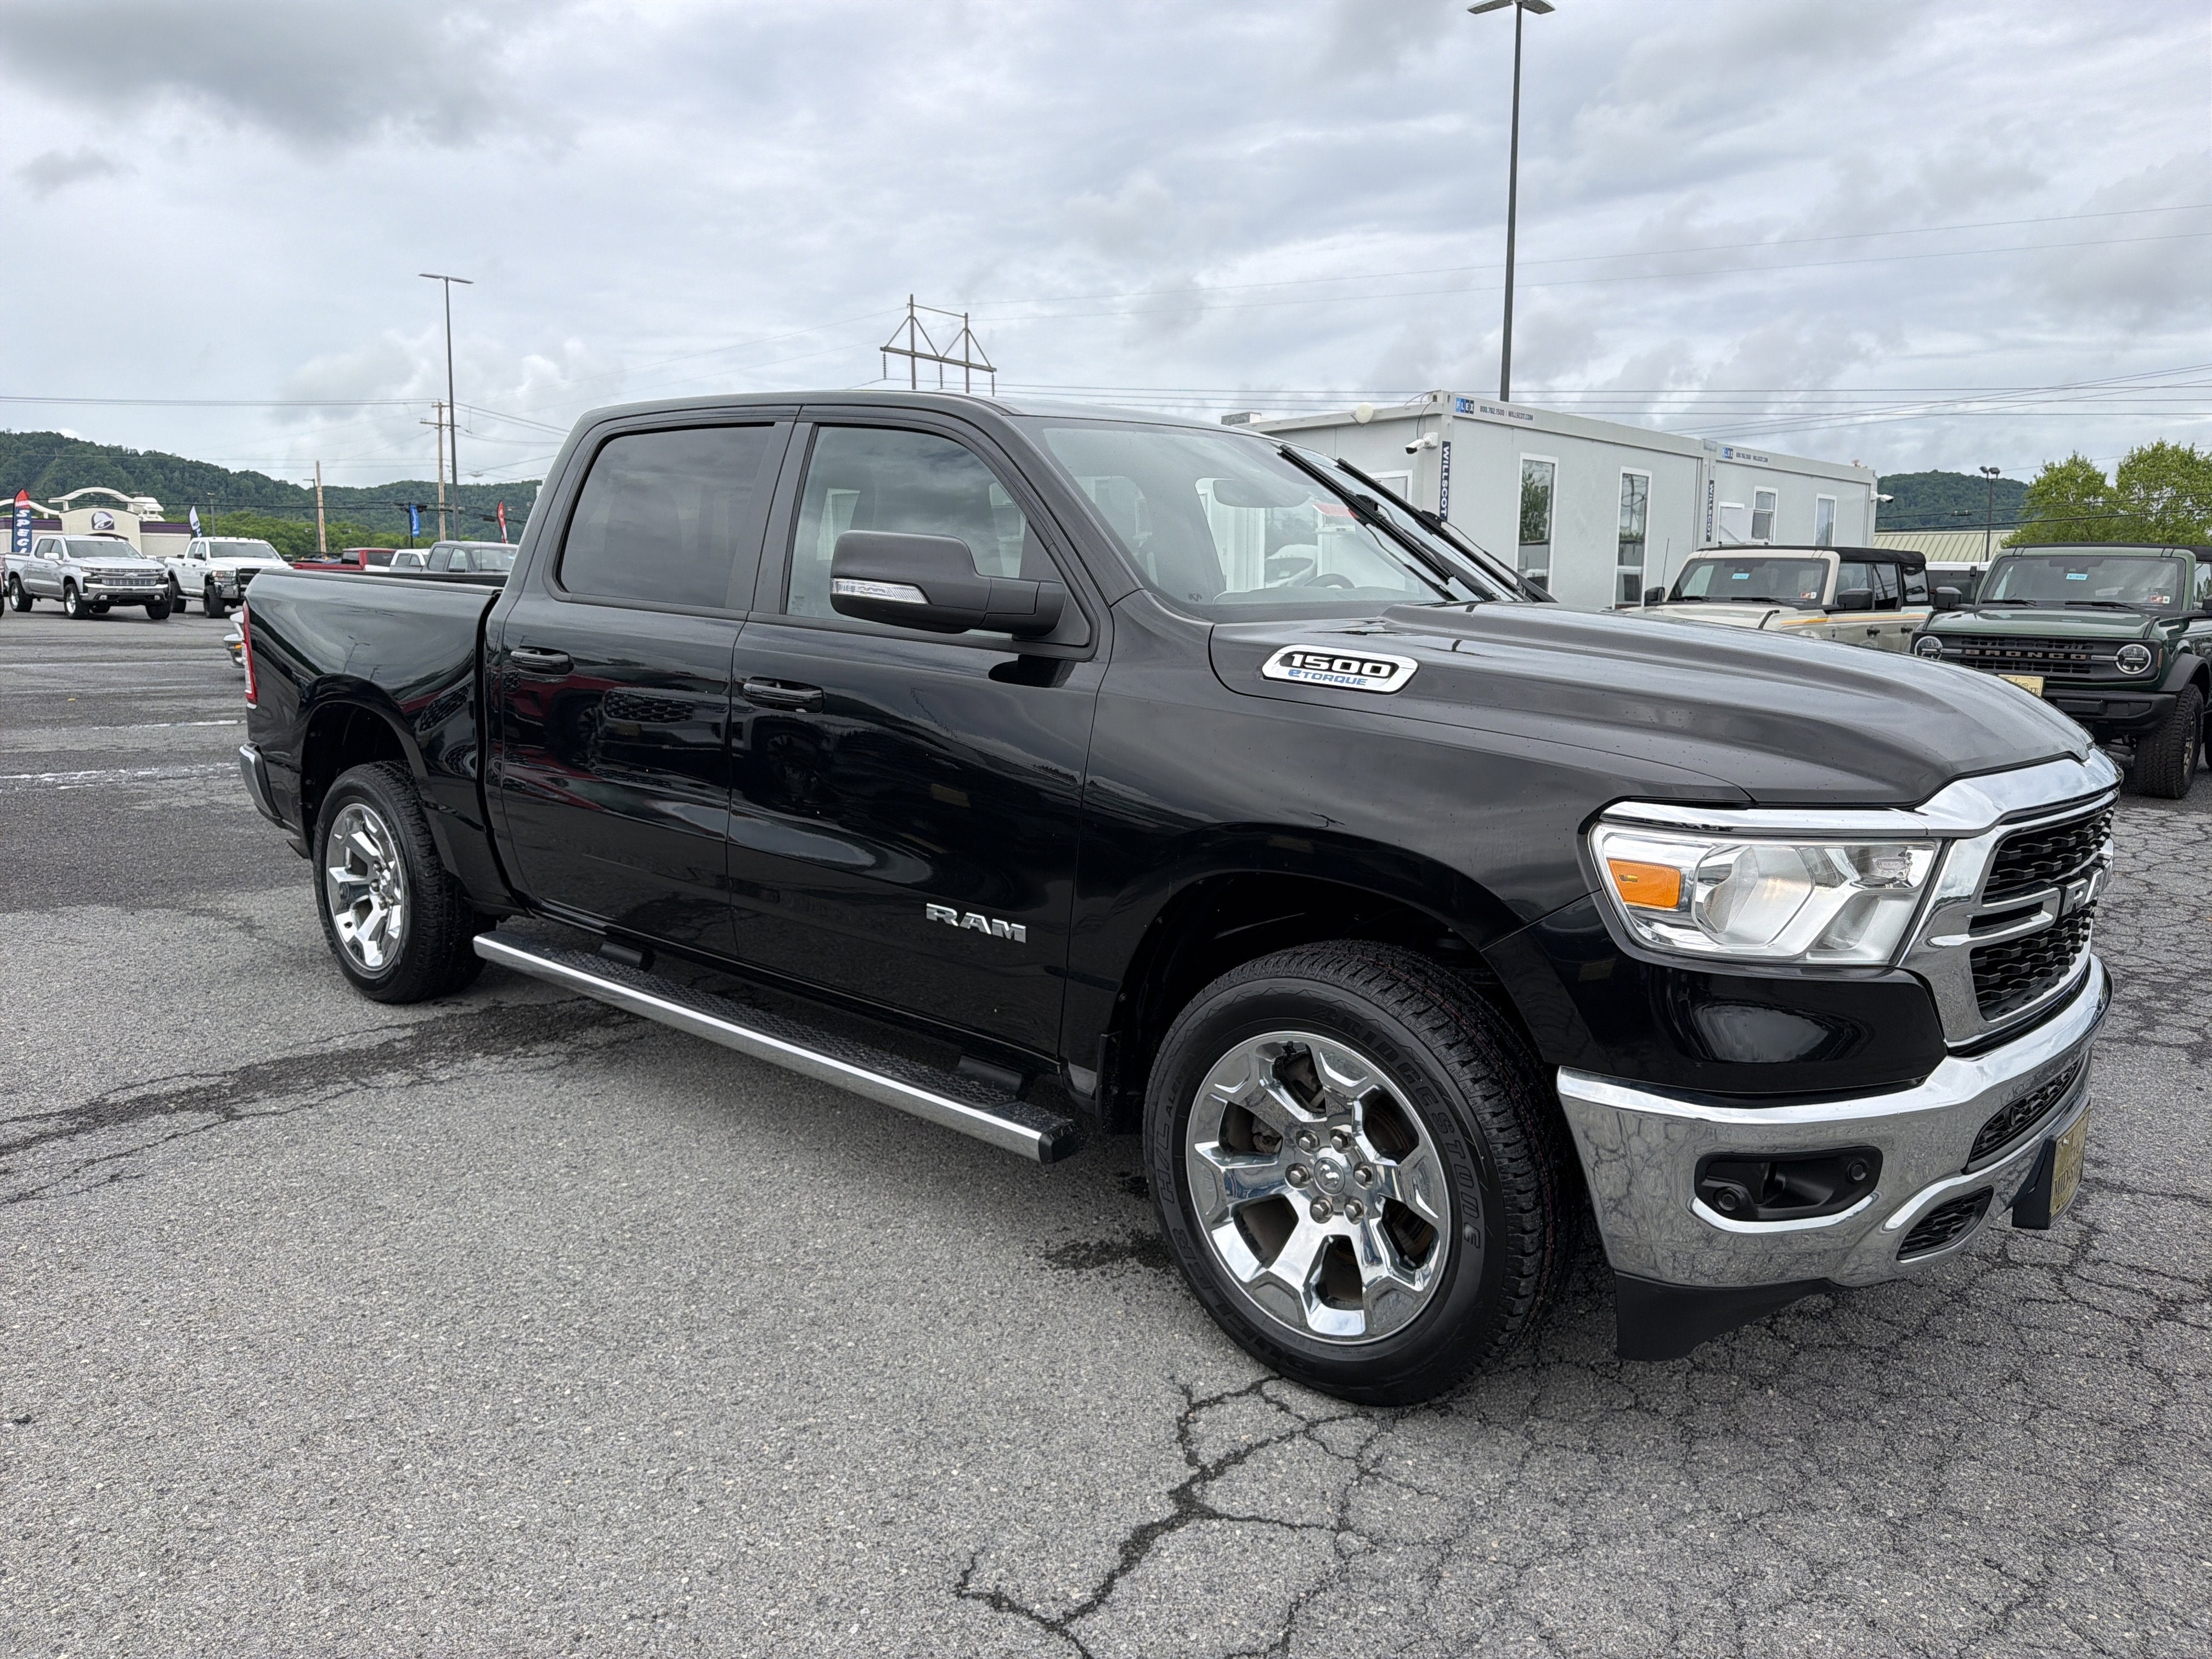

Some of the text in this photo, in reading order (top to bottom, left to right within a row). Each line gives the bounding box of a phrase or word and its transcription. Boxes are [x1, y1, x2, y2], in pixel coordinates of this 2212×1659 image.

[1456, 400, 1474, 413] FLEX
[1508, 411, 1533, 421] WILLSCOT.COM
[1441, 446, 1449, 517] WILLSCOT
[1291, 653, 1392, 678] 1500
[1965, 648, 2086, 661] BRONCO
[926, 902, 1026, 943] RAM
[1311, 1000, 1481, 1250] BRIDGESTONE
